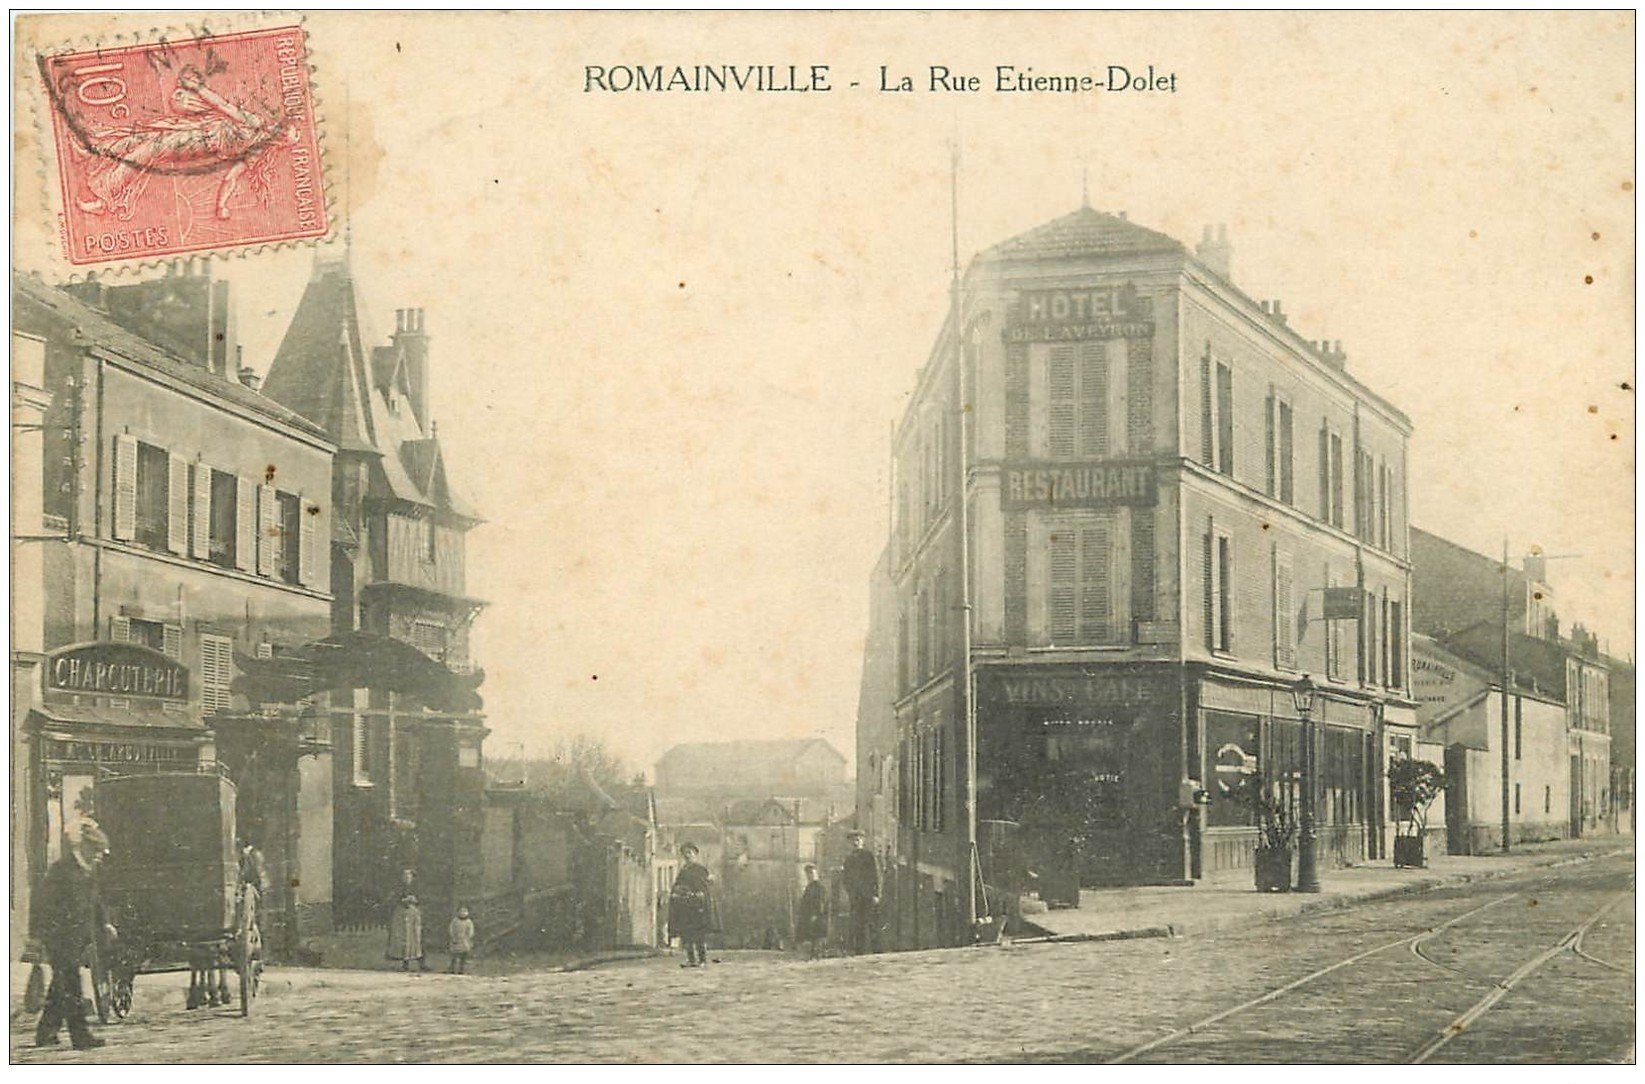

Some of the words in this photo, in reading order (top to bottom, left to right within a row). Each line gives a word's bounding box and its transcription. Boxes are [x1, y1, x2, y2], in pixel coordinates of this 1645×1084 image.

[84, 226, 170, 256] POSTES
[1008, 466, 1149, 501] RESTAURANT
[55, 657, 183, 696] CHARCUTERIE
